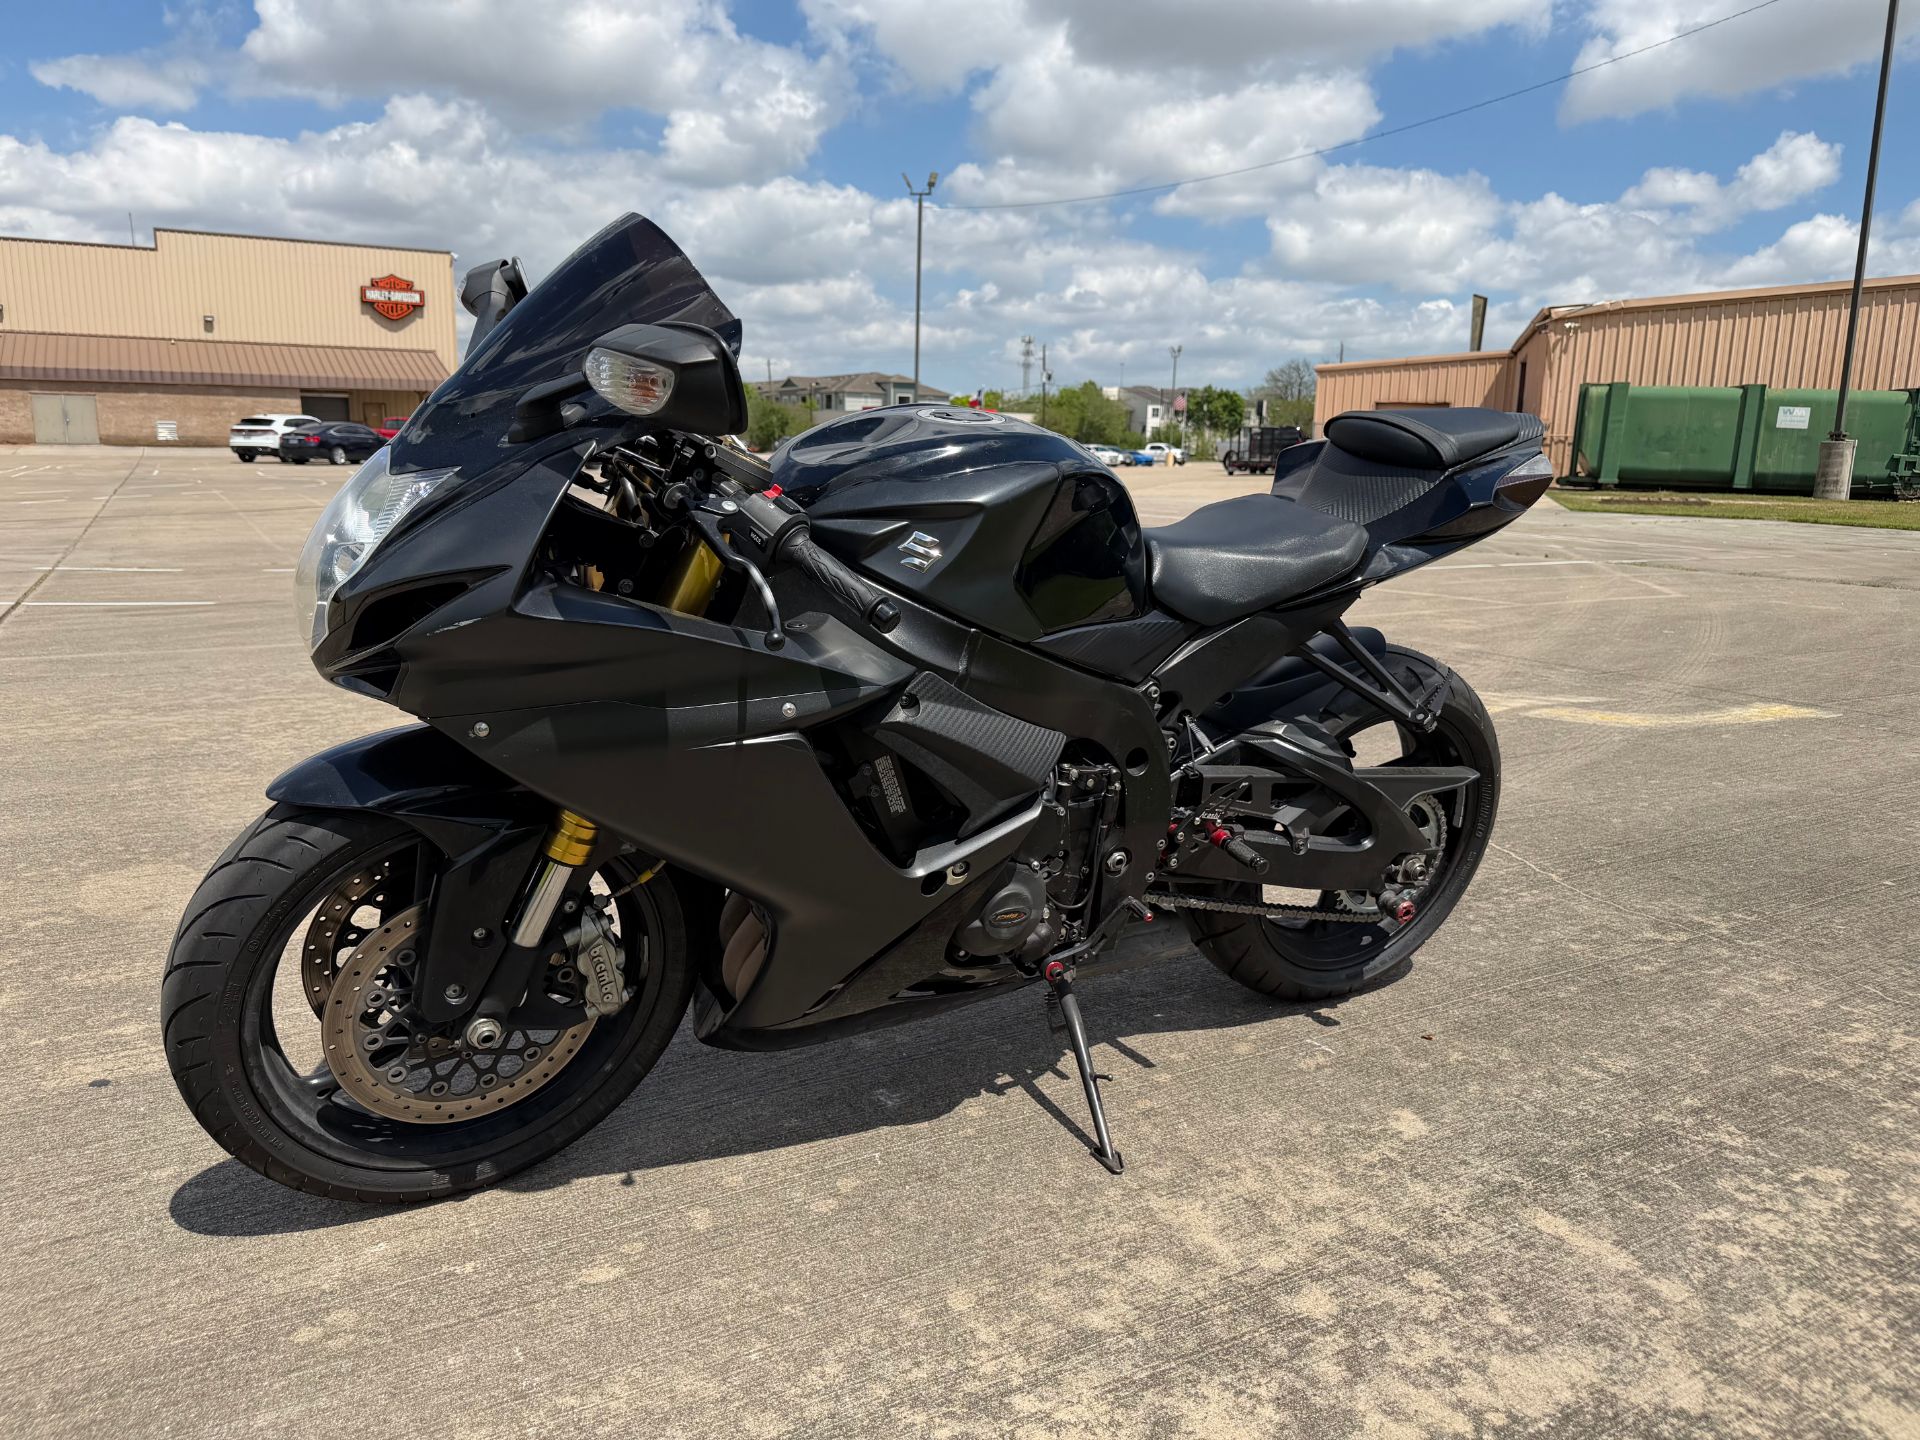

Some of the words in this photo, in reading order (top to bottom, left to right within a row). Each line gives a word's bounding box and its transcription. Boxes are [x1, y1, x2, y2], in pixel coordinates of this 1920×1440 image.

[378, 279, 408, 289] MOTOR
[366, 290, 420, 303] HARLEY-DAVIDSON
[590, 944, 616, 1002] brembo
